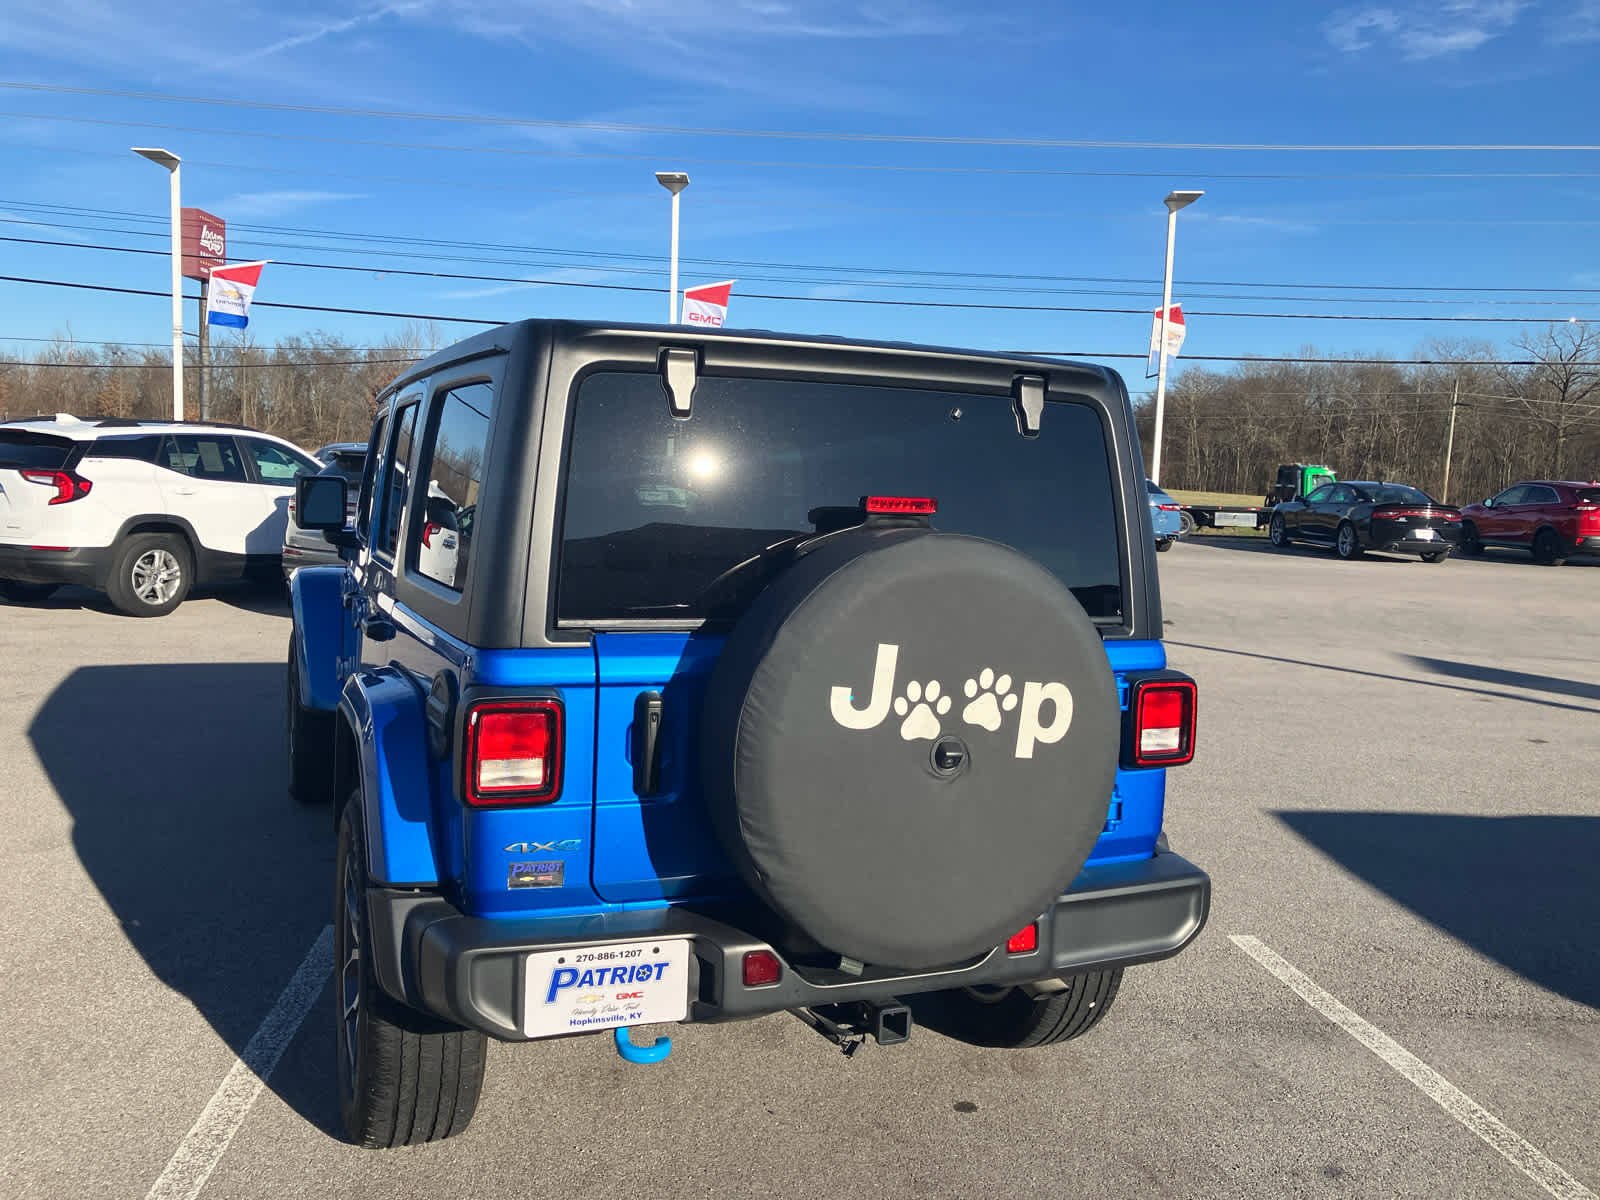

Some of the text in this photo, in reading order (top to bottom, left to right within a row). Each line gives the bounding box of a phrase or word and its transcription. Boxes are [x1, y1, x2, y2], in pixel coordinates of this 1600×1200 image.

[689, 312, 721, 326] GMC
[511, 863, 562, 878] PATRIOT
[576, 950, 642, 963] 270-886-1207
[545, 962, 670, 1005] PATRIOT
[616, 991, 645, 1001] GMC
[569, 1012, 643, 1027] Hopkinsville, KY
